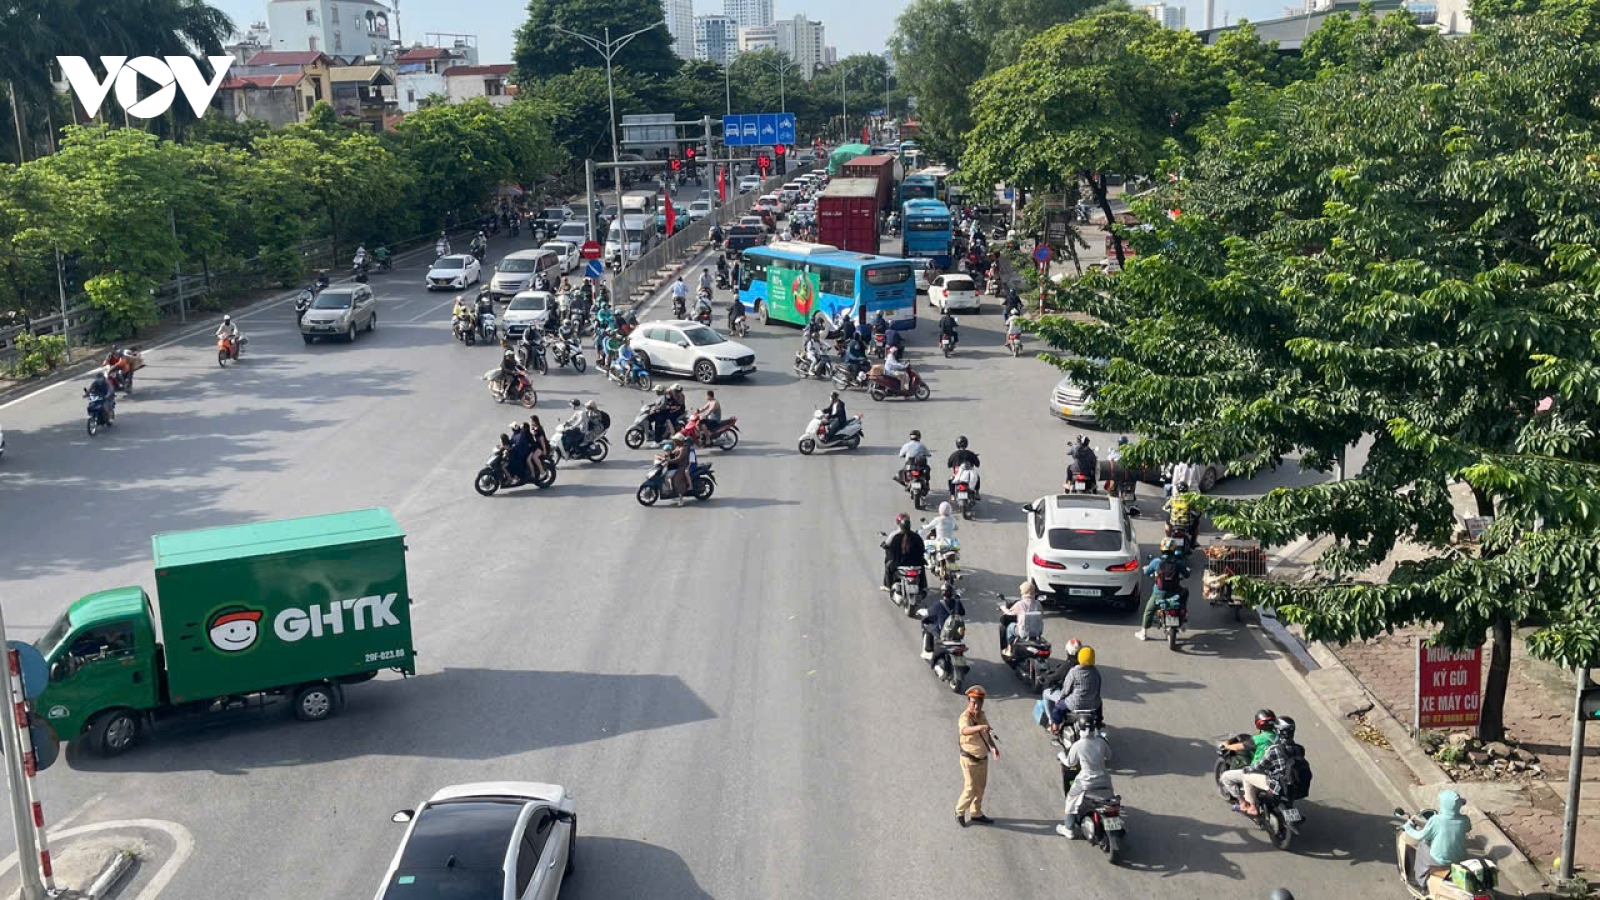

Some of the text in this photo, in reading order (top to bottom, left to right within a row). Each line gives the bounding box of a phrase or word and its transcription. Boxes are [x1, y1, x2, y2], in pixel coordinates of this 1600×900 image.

[671, 159, 681, 170] 12
[274, 593, 401, 642] GHTK
[1434, 669, 1447, 686] KÝ
[1422, 696, 1435, 711] XE
[1439, 693, 1461, 710] MÁY
